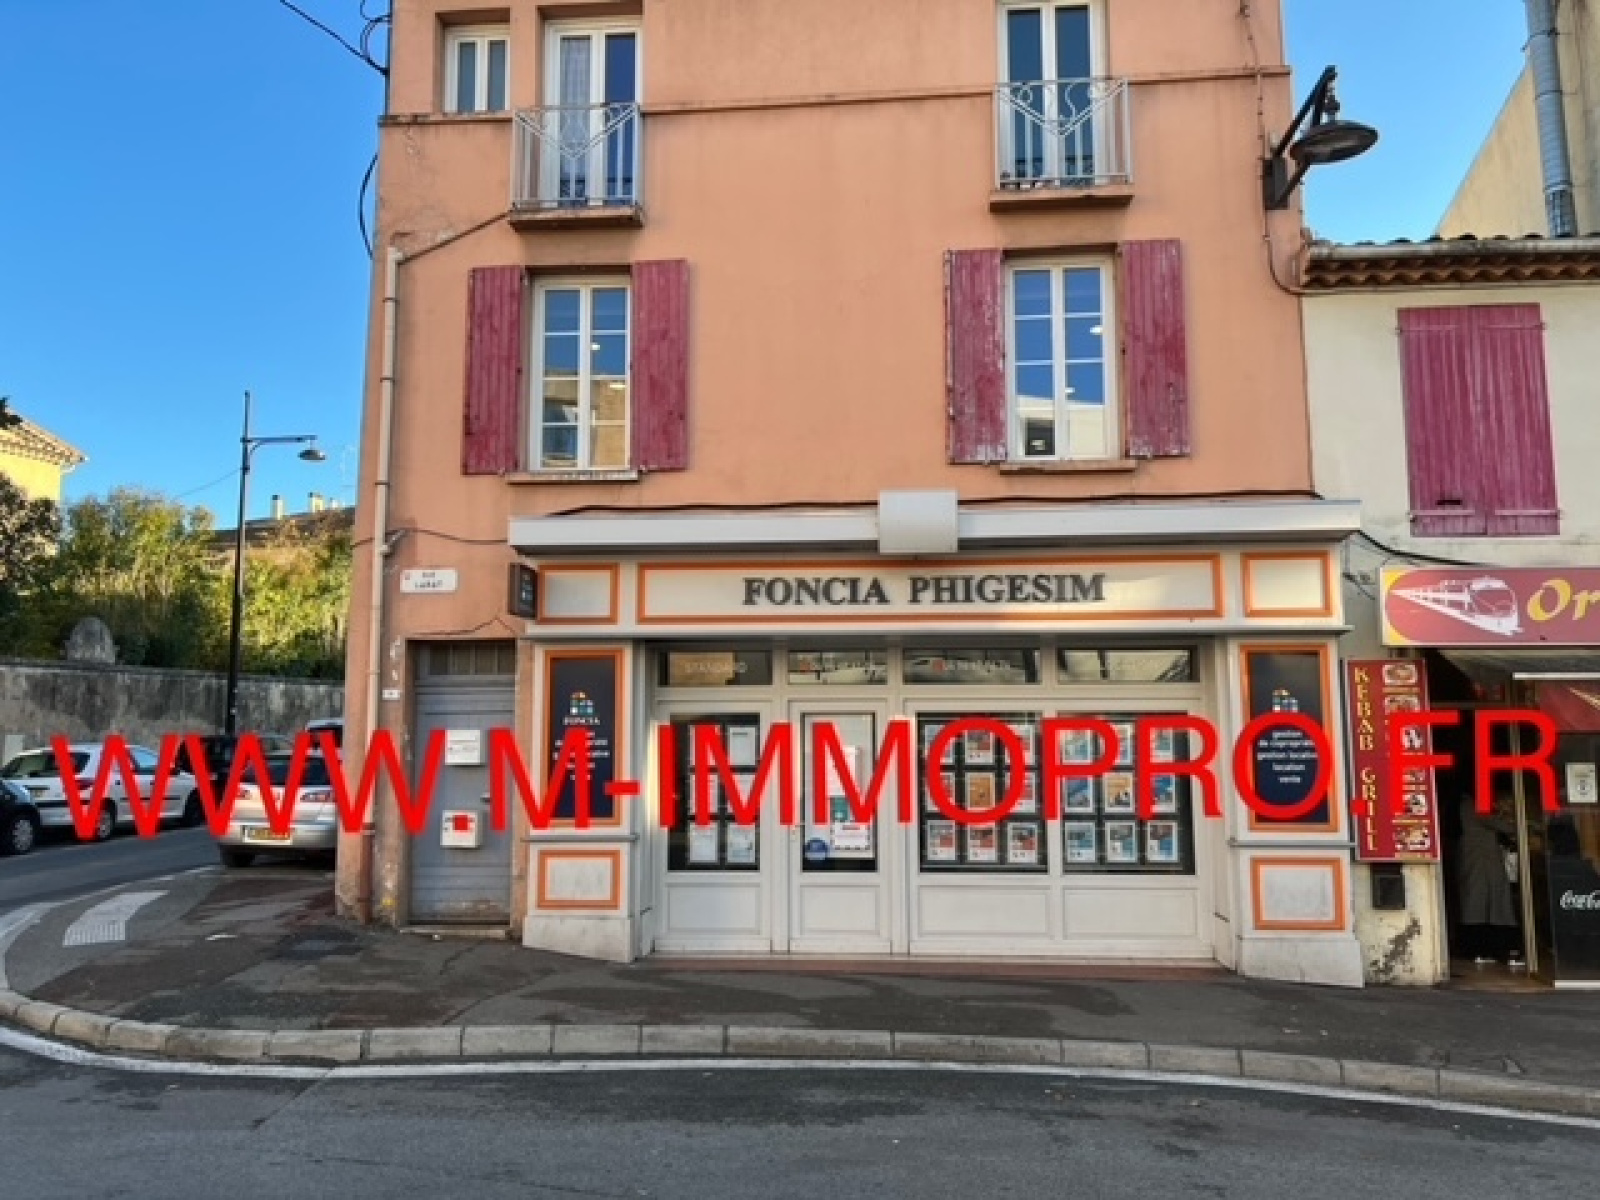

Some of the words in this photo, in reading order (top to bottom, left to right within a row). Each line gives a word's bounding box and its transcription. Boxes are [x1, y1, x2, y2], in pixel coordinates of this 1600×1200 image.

[742, 576, 891, 606] FONCIA
[908, 573, 1106, 603] PHIGESIM
[1354, 667, 1374, 750] KEBAB
[1360, 767, 1378, 850] GRILL
